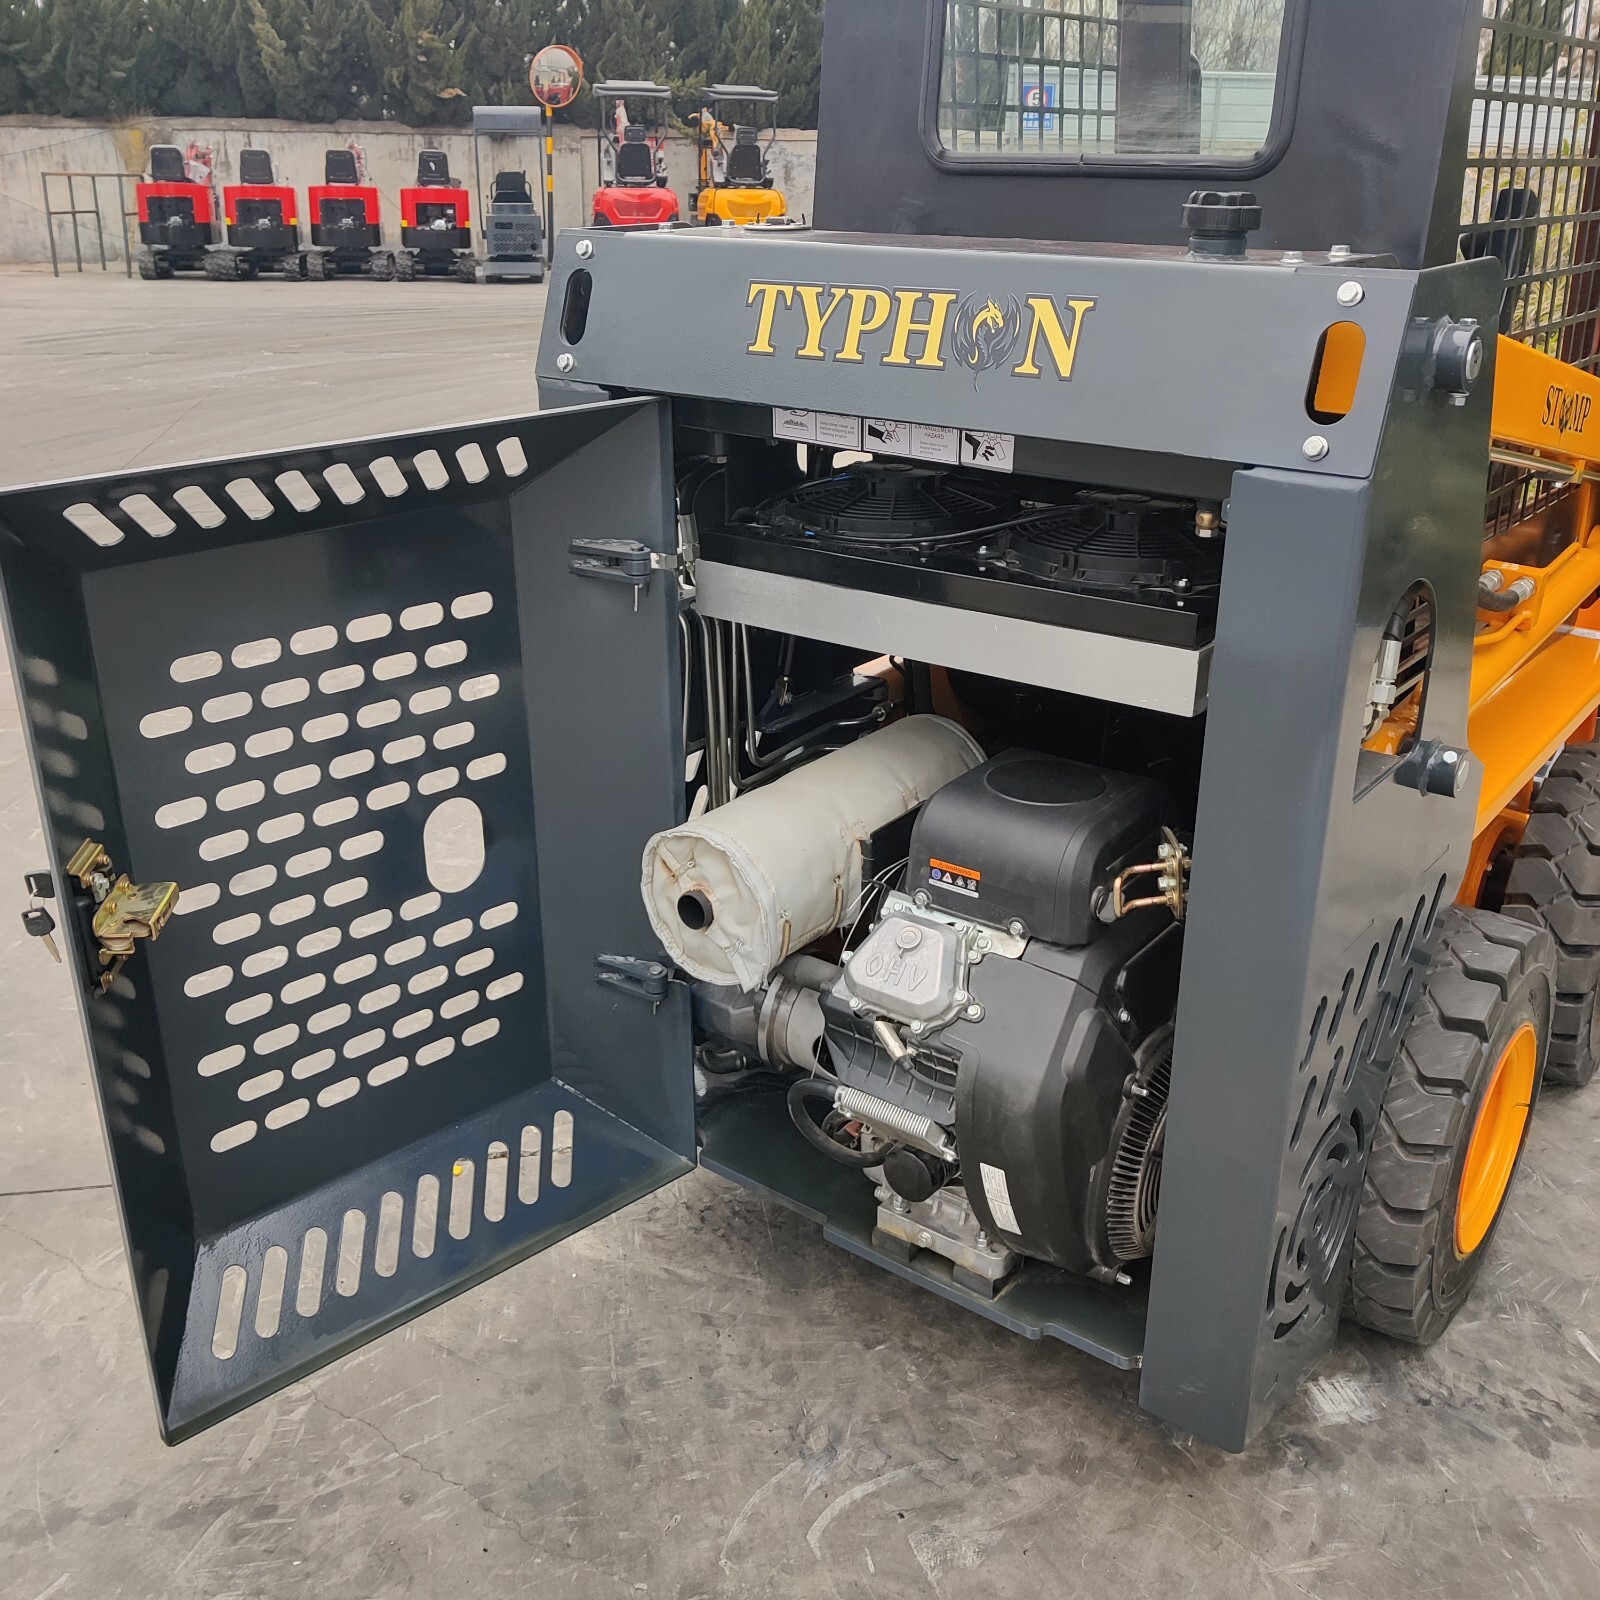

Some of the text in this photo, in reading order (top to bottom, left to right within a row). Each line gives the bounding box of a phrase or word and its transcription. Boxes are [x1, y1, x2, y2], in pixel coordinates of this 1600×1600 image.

[745, 278, 1099, 388] TYPHON
[924, 432, 945, 440] HAZARD
[944, 865, 972, 877] WARNING
[865, 952, 928, 991] OHV
